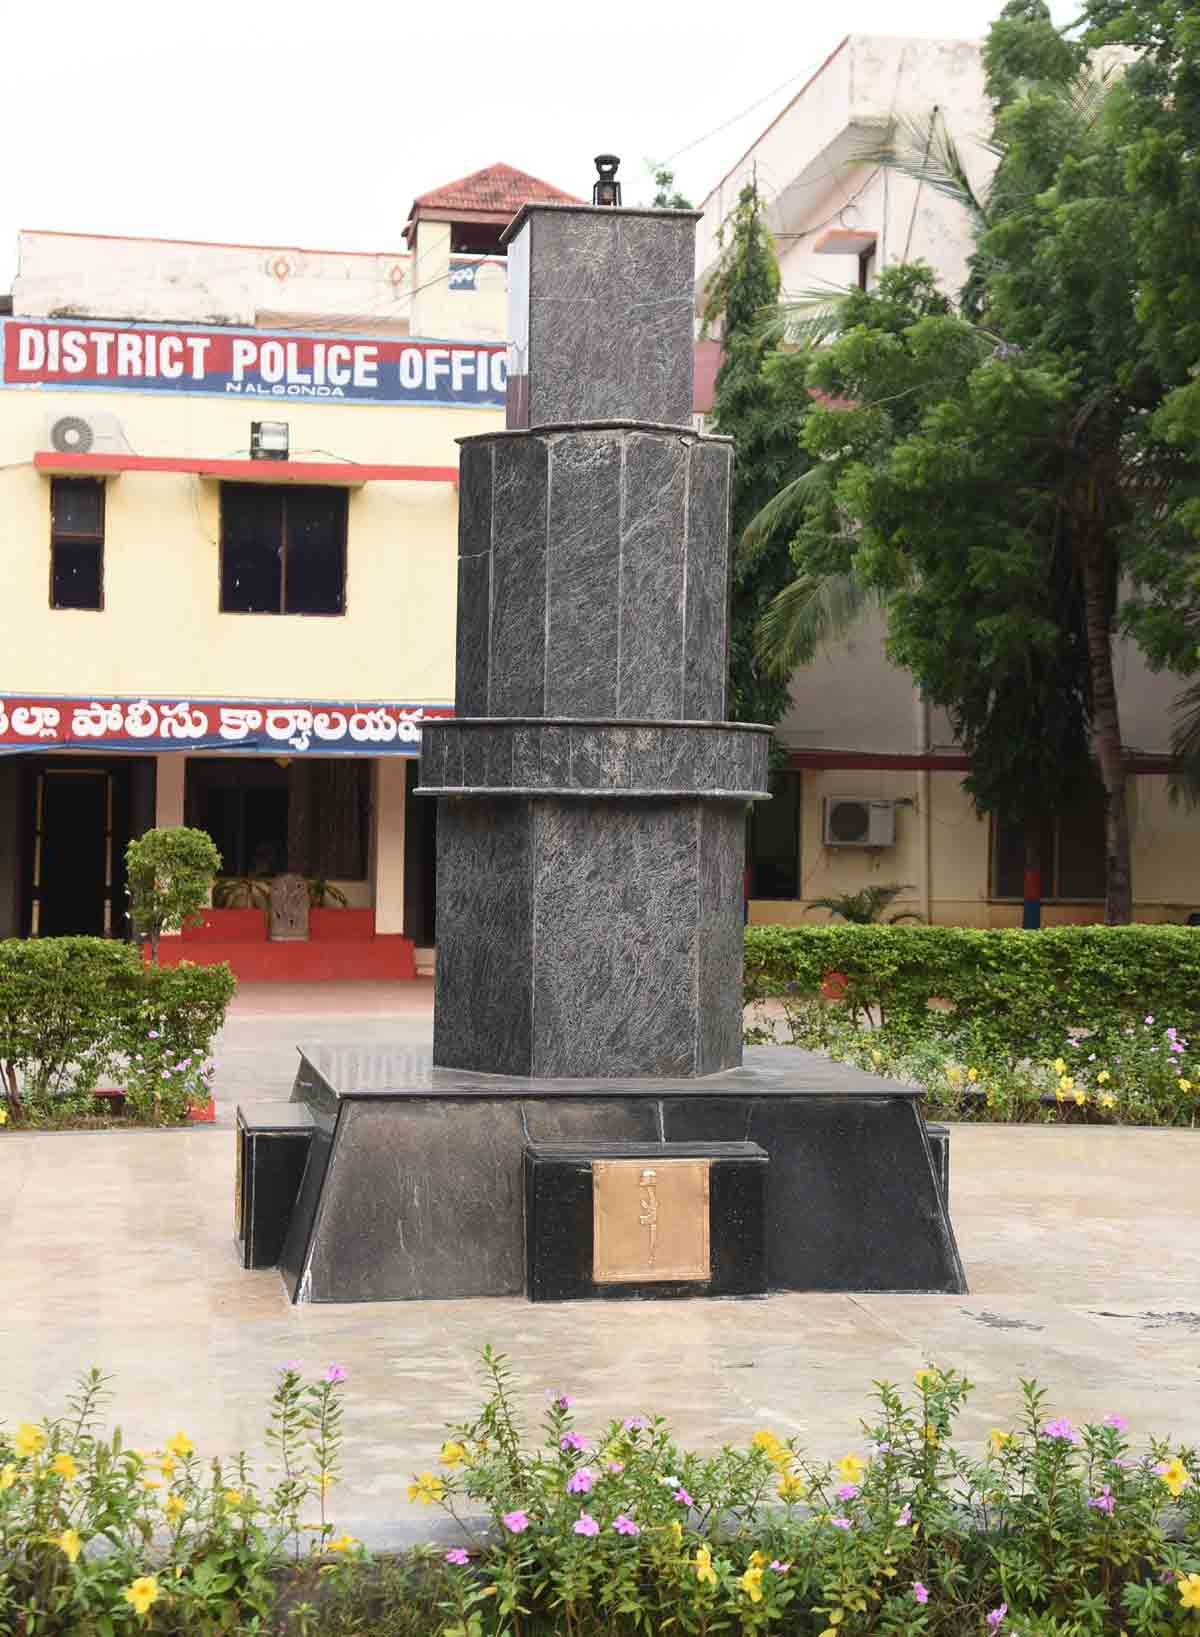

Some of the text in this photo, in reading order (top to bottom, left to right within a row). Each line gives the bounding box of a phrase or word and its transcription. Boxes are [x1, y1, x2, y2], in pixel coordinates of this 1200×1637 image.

[17, 328, 507, 393] DISTRICT POLICE OFFIC
[225, 381, 345, 397] NALGONDA
